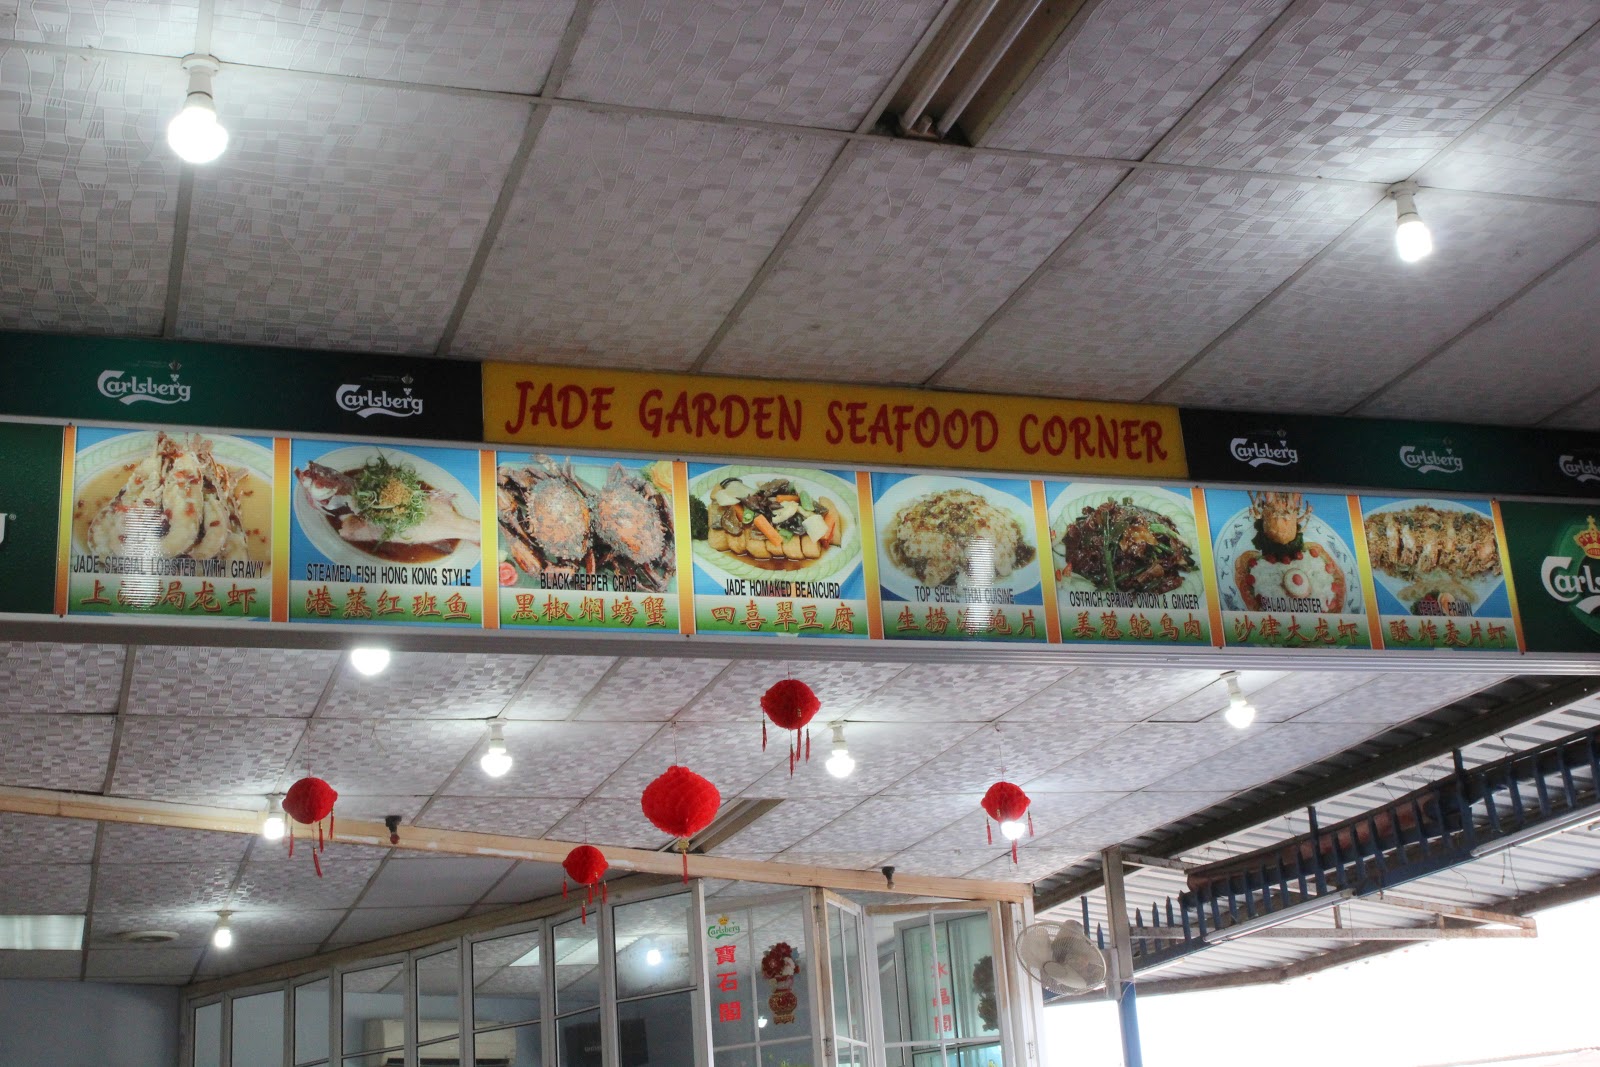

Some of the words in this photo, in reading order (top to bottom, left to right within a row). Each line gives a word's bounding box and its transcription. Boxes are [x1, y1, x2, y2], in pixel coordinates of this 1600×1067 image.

[97, 370, 192, 406] Carlsberg
[335, 383, 424, 419] Carlsberg
[505, 381, 615, 435] JADE
[639, 389, 803, 442] GARDEN
[825, 401, 999, 453] SEAFOOD
[1019, 413, 1168, 463] CORNER
[1230, 437, 1299, 468] Carlsberg
[1399, 445, 1464, 475] Carlsberg
[73, 555, 99, 573] JADE
[104, 557, 146, 574] SPECIAL
[151, 558, 197, 577] LOBSTER
[202, 559, 226, 577] WITH
[231, 560, 264, 579] GRAVY
[306, 563, 351, 582] STEAMED
[356, 565, 377, 584] FISH
[381, 566, 408, 585] HONG
[412, 567, 438, 586] KONG
[441, 568, 471, 586] STYLE
[540, 572, 570, 590] BLACK
[574, 573, 608, 591] PEPPER
[612, 575, 637, 592] CRAB
[724, 578, 747, 596] JADE
[750, 579, 792, 598] HOMAKED
[796, 581, 840, 599] BEANCURD
[914, 585, 931, 602] TOP
[935, 586, 960, 603] SHELL
[963, 587, 982, 604] THAI
[985, 588, 1015, 605] CUISINE
[1069, 591, 1102, 607] OSTRICH
[1106, 591, 1134, 608] SPRING
[1136, 592, 1160, 608] ONION
[1163, 593, 1168, 609] &
[1171, 593, 1200, 610] GINGER
[1261, 596, 1287, 612] SALAD
[1289, 597, 1322, 613] LOBSTER
[710, 600, 855, 633] 四喜翠豆腐
[707, 924, 741, 939] Carlsberg
